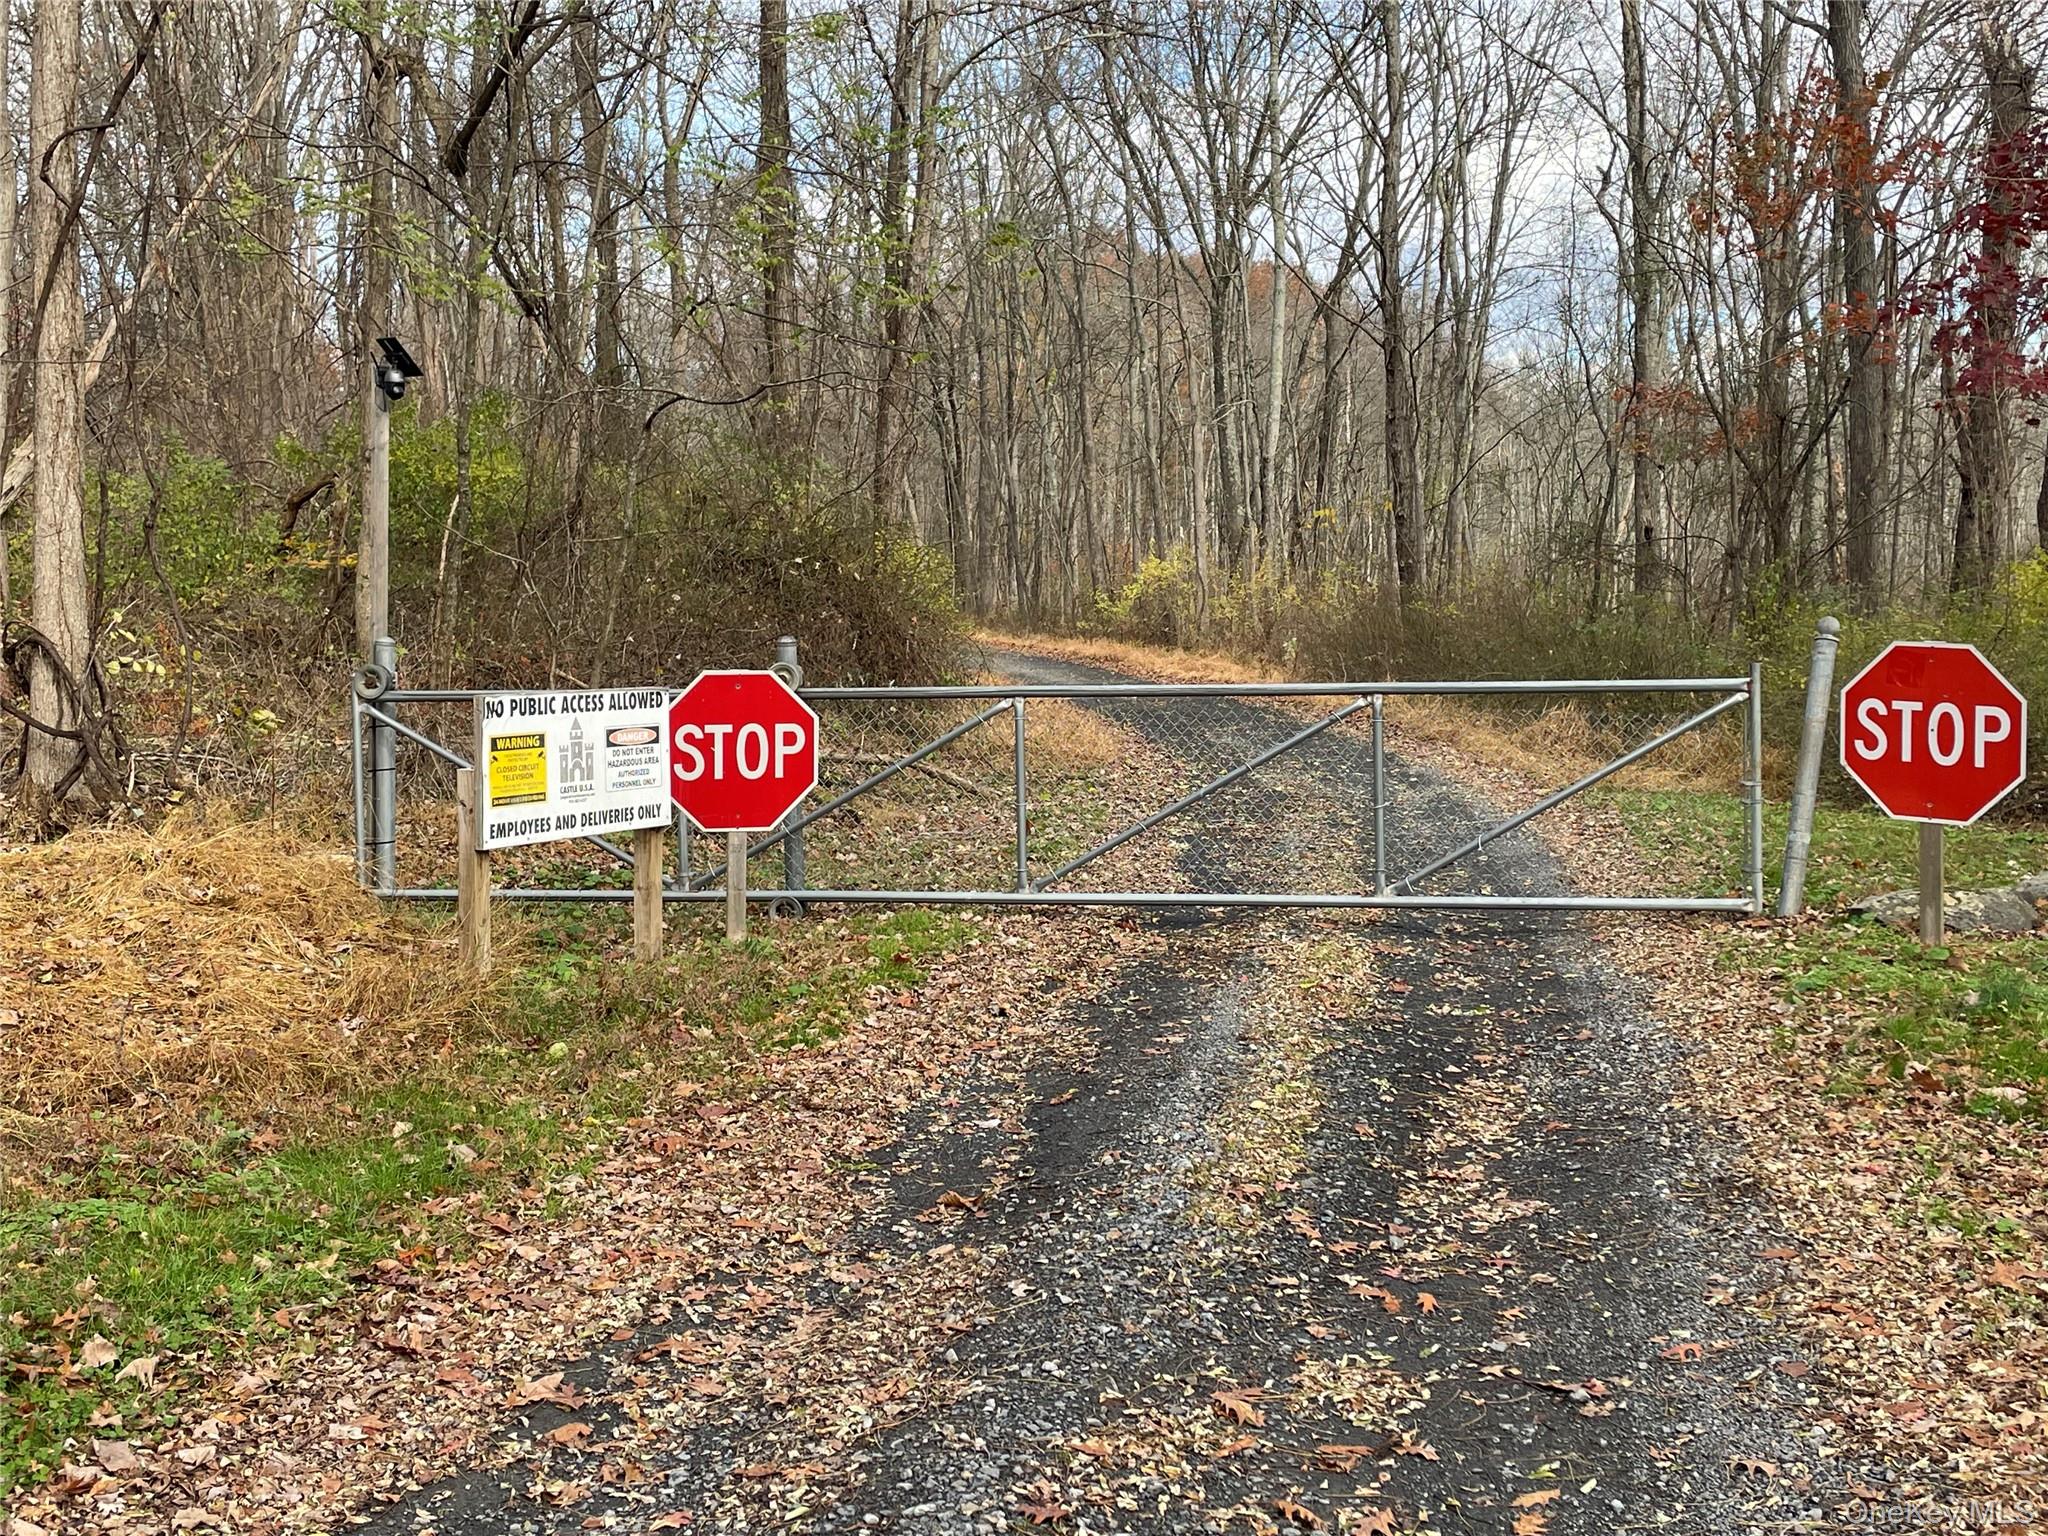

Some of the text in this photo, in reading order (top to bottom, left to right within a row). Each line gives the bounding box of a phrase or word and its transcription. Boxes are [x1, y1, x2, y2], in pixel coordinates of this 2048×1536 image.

[486, 691, 663, 719] NO PUBLIC ACCESS ALLOWED
[617, 731, 649, 742] DANGER
[1854, 697, 2011, 768] STOP
[496, 736, 540, 750] WARNING
[612, 746, 654, 757] DO NOT ENTER
[673, 723, 806, 781] STOP
[607, 756, 659, 768] HAZARDOUS AREA
[496, 763, 539, 774] CLOSED CIRCUIT
[618, 768, 650, 778] AUTHORIZED
[503, 772, 534, 782] TELEVISION
[612, 777, 656, 789] PERSONNEL ONLY
[560, 785, 578, 794] CASTLE
[490, 802, 662, 840] EMPLOYEES AND DELIVERIES ONLY
